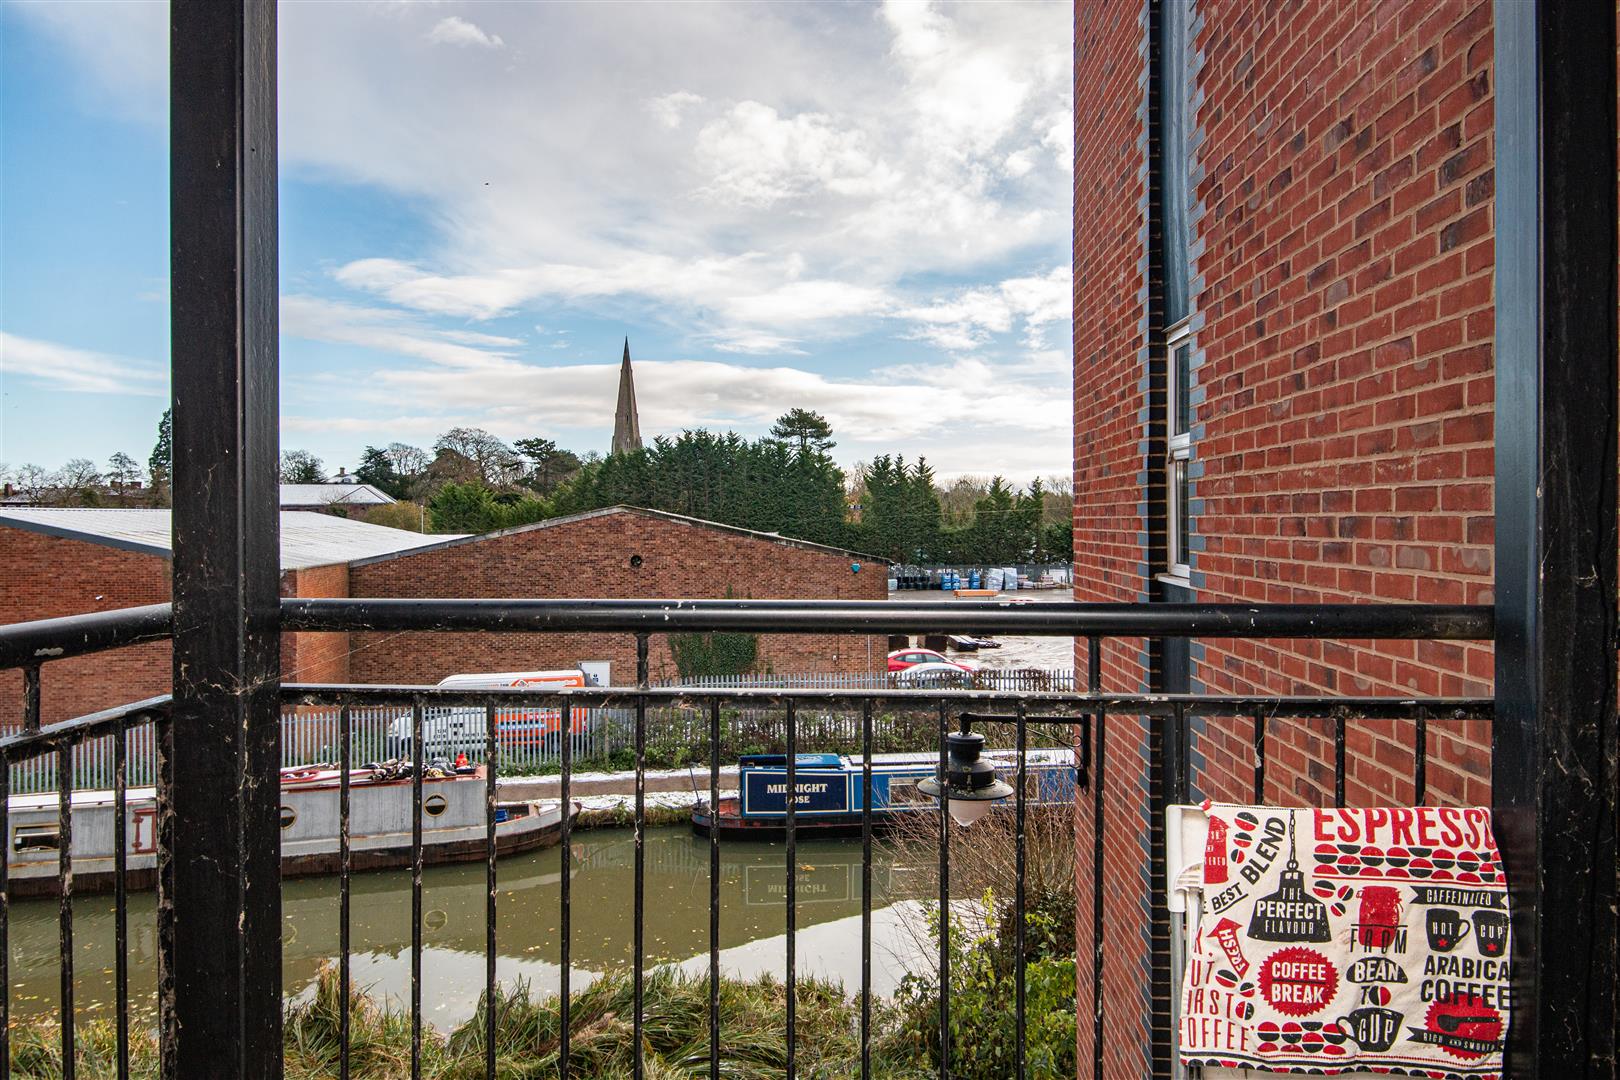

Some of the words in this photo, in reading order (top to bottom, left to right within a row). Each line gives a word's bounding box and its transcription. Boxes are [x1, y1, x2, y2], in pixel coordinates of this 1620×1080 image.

[1240, 817, 1286, 885] BLEND
[1211, 882, 1245, 912] BEST
[1282, 887, 1301, 900] THE
[1426, 889, 1492, 906] CAFFEINATED
[1256, 900, 1324, 919] PERFECT
[1265, 920, 1314, 934] FLAVOUR
[1433, 921, 1453, 935] HOT
[1480, 924, 1503, 939] CUP
[1218, 928, 1247, 972] FRESH
[1350, 927, 1407, 954] FROM
[1271, 961, 1327, 980] COFFEE
[1354, 959, 1399, 981] BEAN
[1424, 955, 1511, 982] ARABICA
[1271, 984, 1325, 1003] BREAK
[1420, 979, 1511, 1010] COFFEE
[1358, 1013, 1394, 1045] CUP
[1423, 1032, 1443, 1043] RICH
